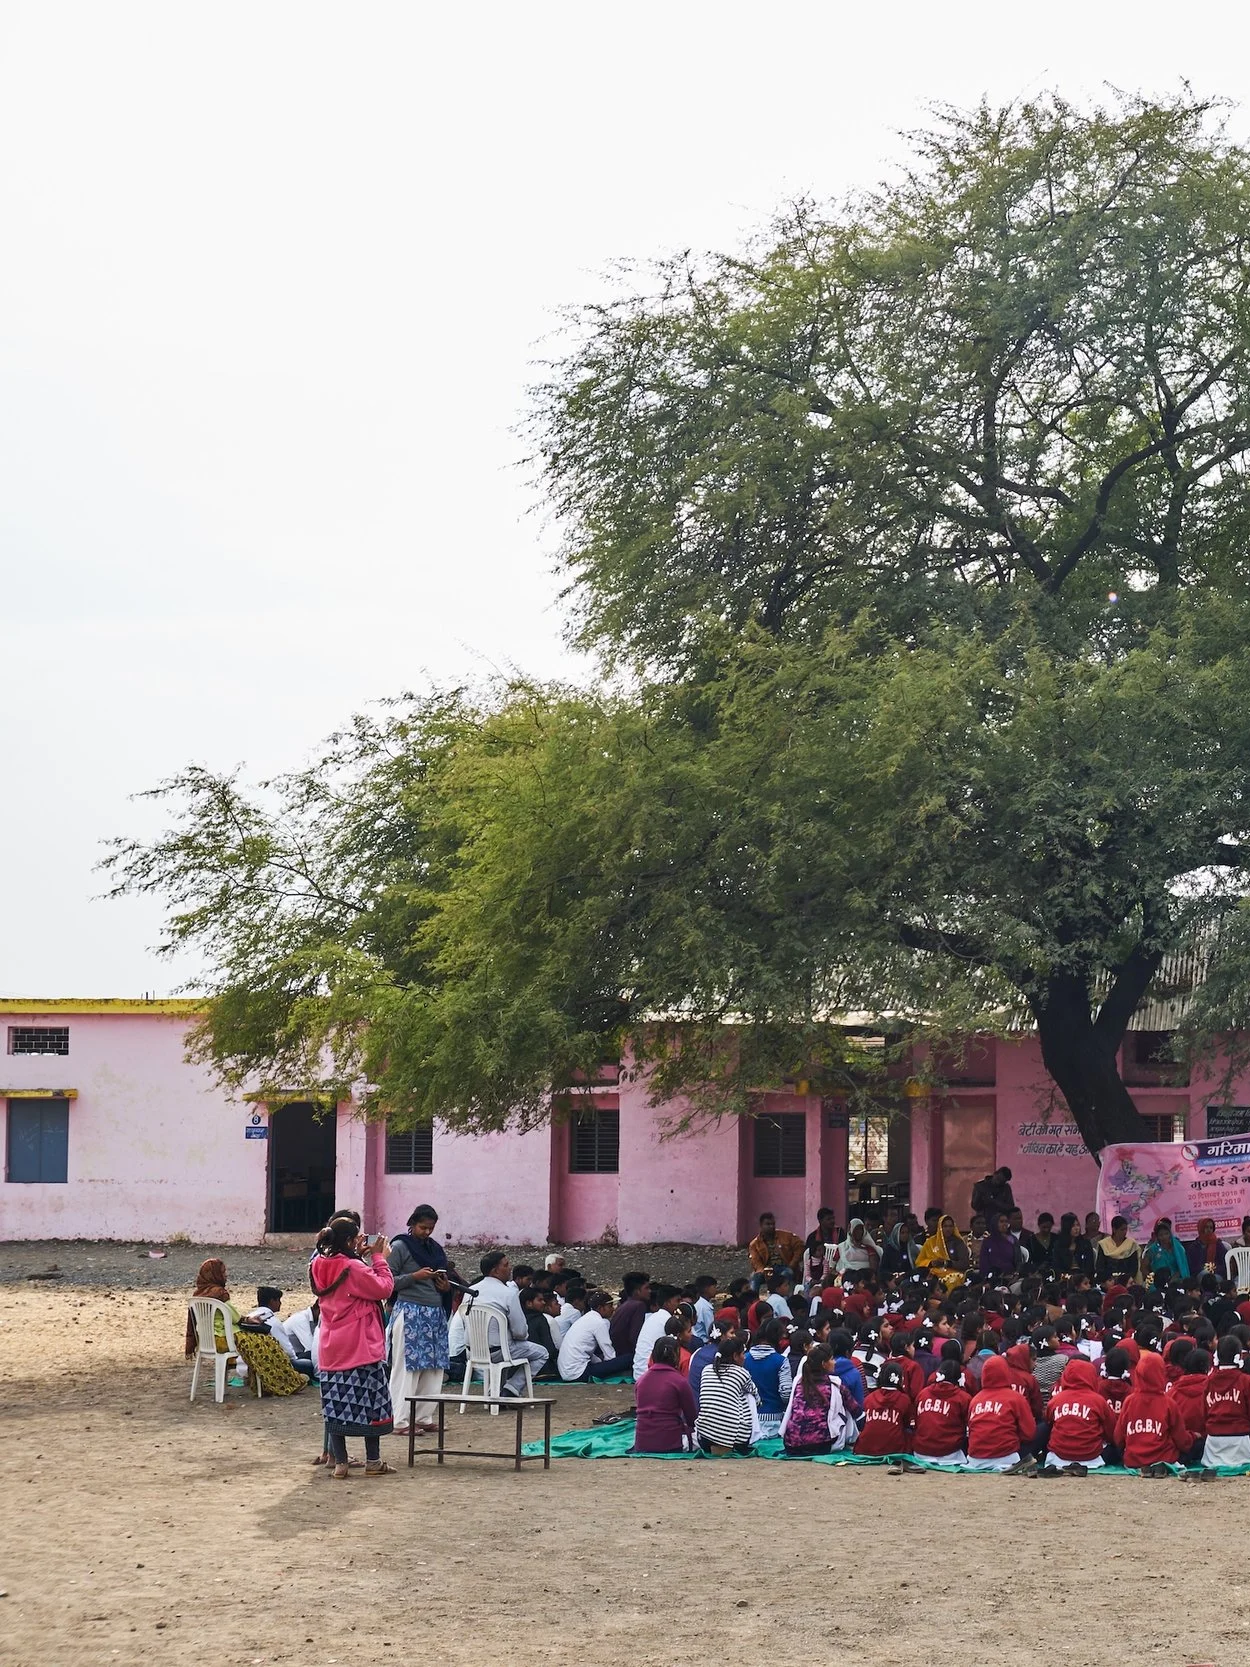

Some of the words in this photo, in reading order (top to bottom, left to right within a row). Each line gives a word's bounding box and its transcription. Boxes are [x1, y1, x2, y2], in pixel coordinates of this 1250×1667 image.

[1190, 1175, 1225, 1190] मुम्बई
[1228, 1174, 1239, 1186] से
[1053, 1402, 1091, 1421] K.G.B.V.
[1126, 1418, 1163, 1437] K.G.B.V.
